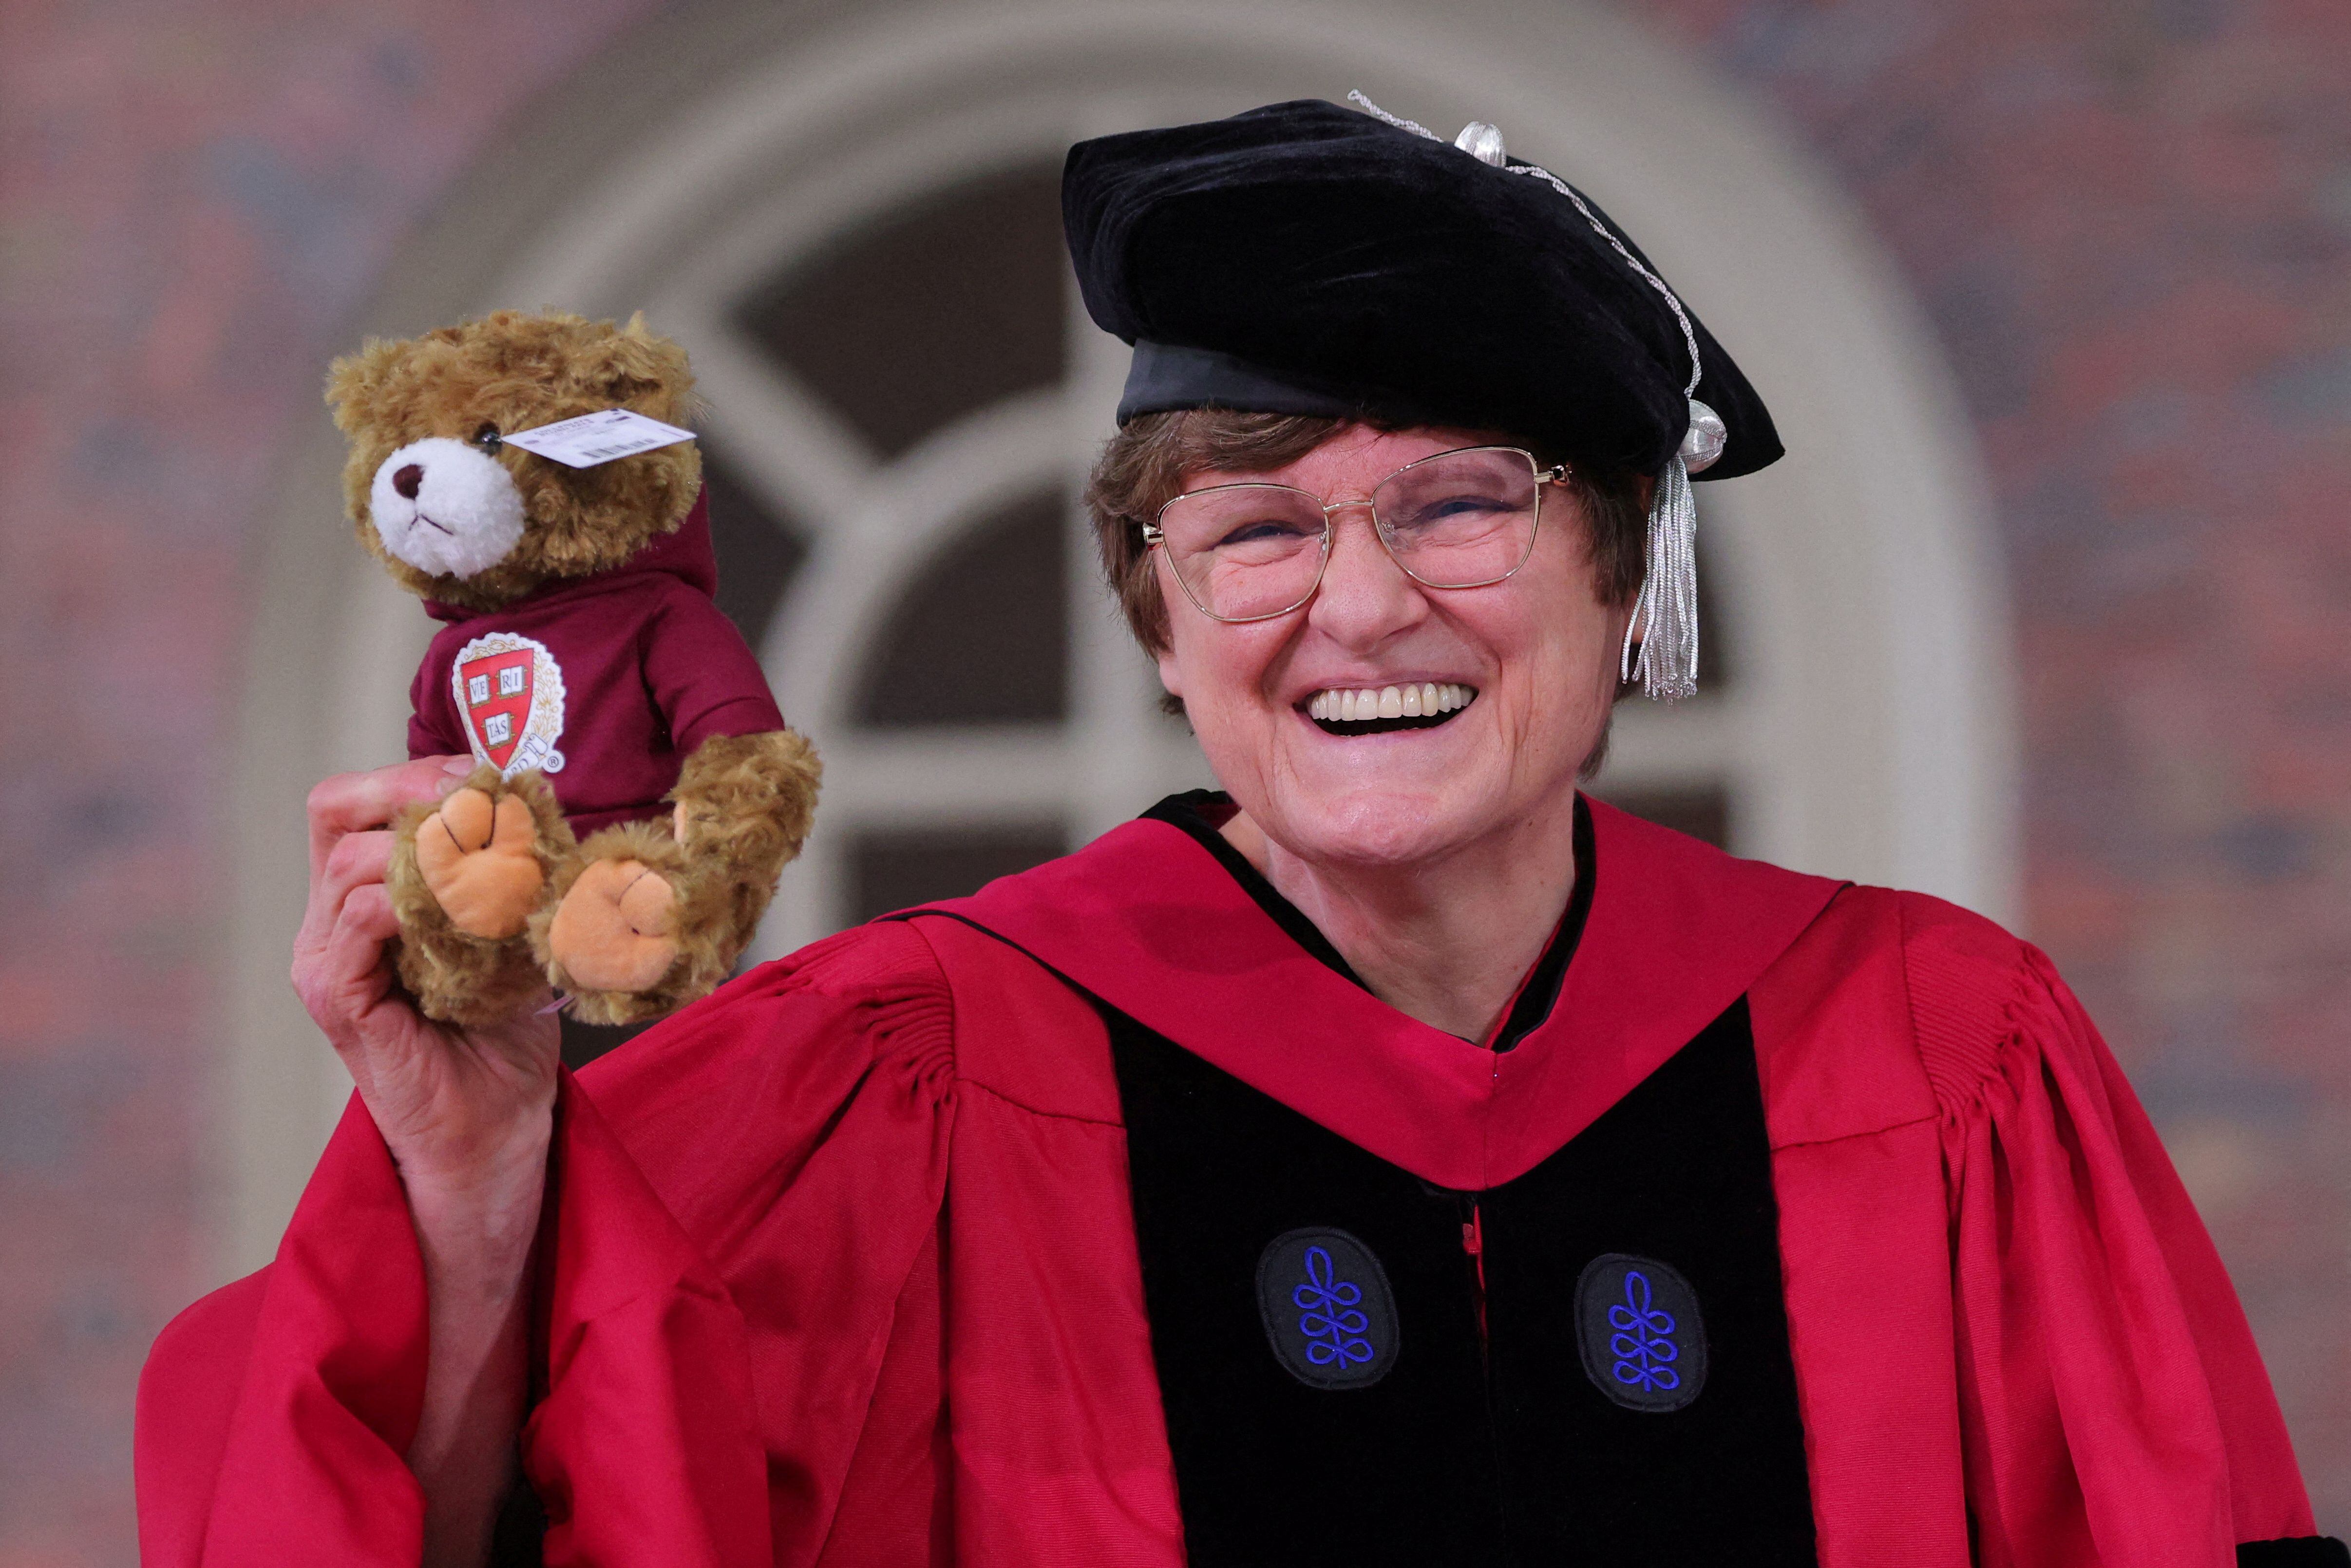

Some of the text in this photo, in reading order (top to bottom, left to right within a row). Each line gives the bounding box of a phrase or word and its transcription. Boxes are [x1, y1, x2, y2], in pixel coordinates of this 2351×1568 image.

[471, 673, 518, 697] VE RI
[488, 720, 507, 737] TAS
